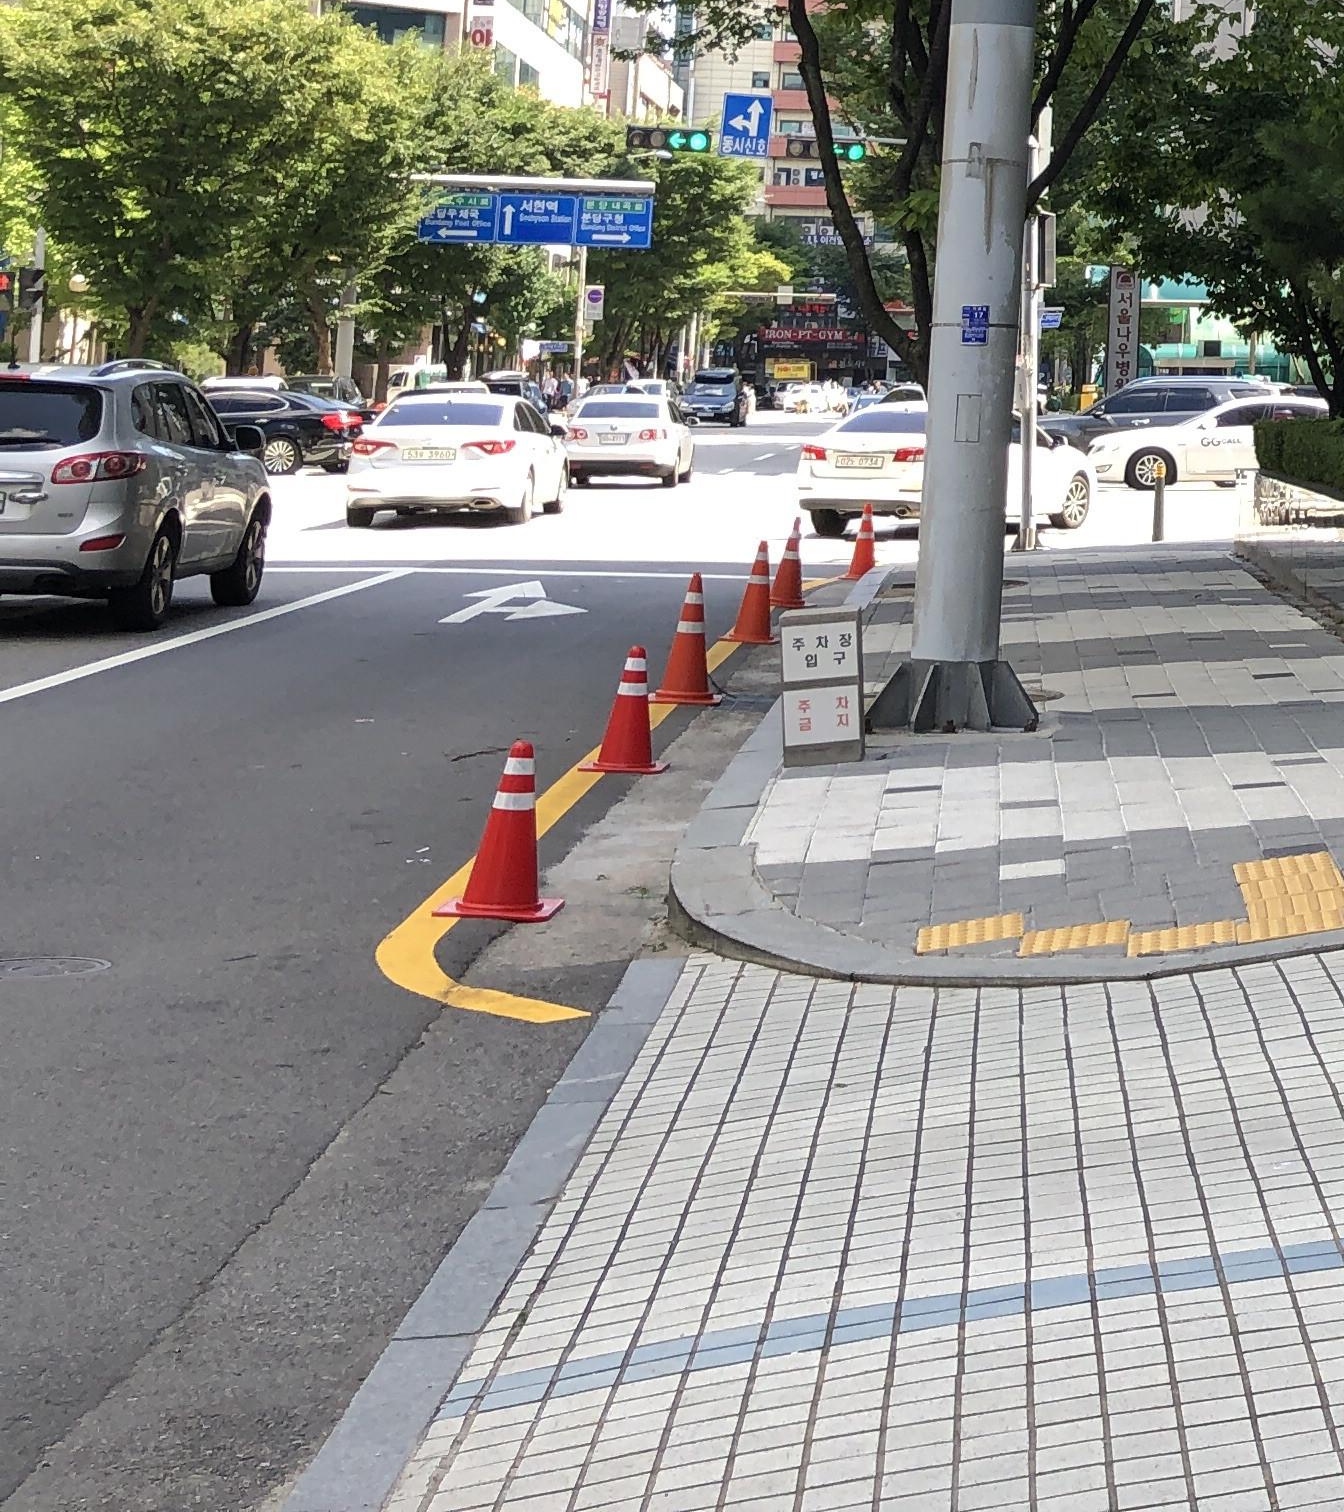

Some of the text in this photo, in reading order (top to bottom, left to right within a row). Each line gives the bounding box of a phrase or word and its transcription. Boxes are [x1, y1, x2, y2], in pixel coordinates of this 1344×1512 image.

[722, 135, 766, 155] 동시신호
[520, 200, 558, 213] 서현역
[581, 212, 624, 224] 분당구청
[765, 329, 843, 340] IRON-PT-GYM
[792, 633, 853, 651] 주차장
[805, 651, 846, 668] 입구
[798, 696, 849, 713] 주차
[799, 714, 849, 731] 금지
